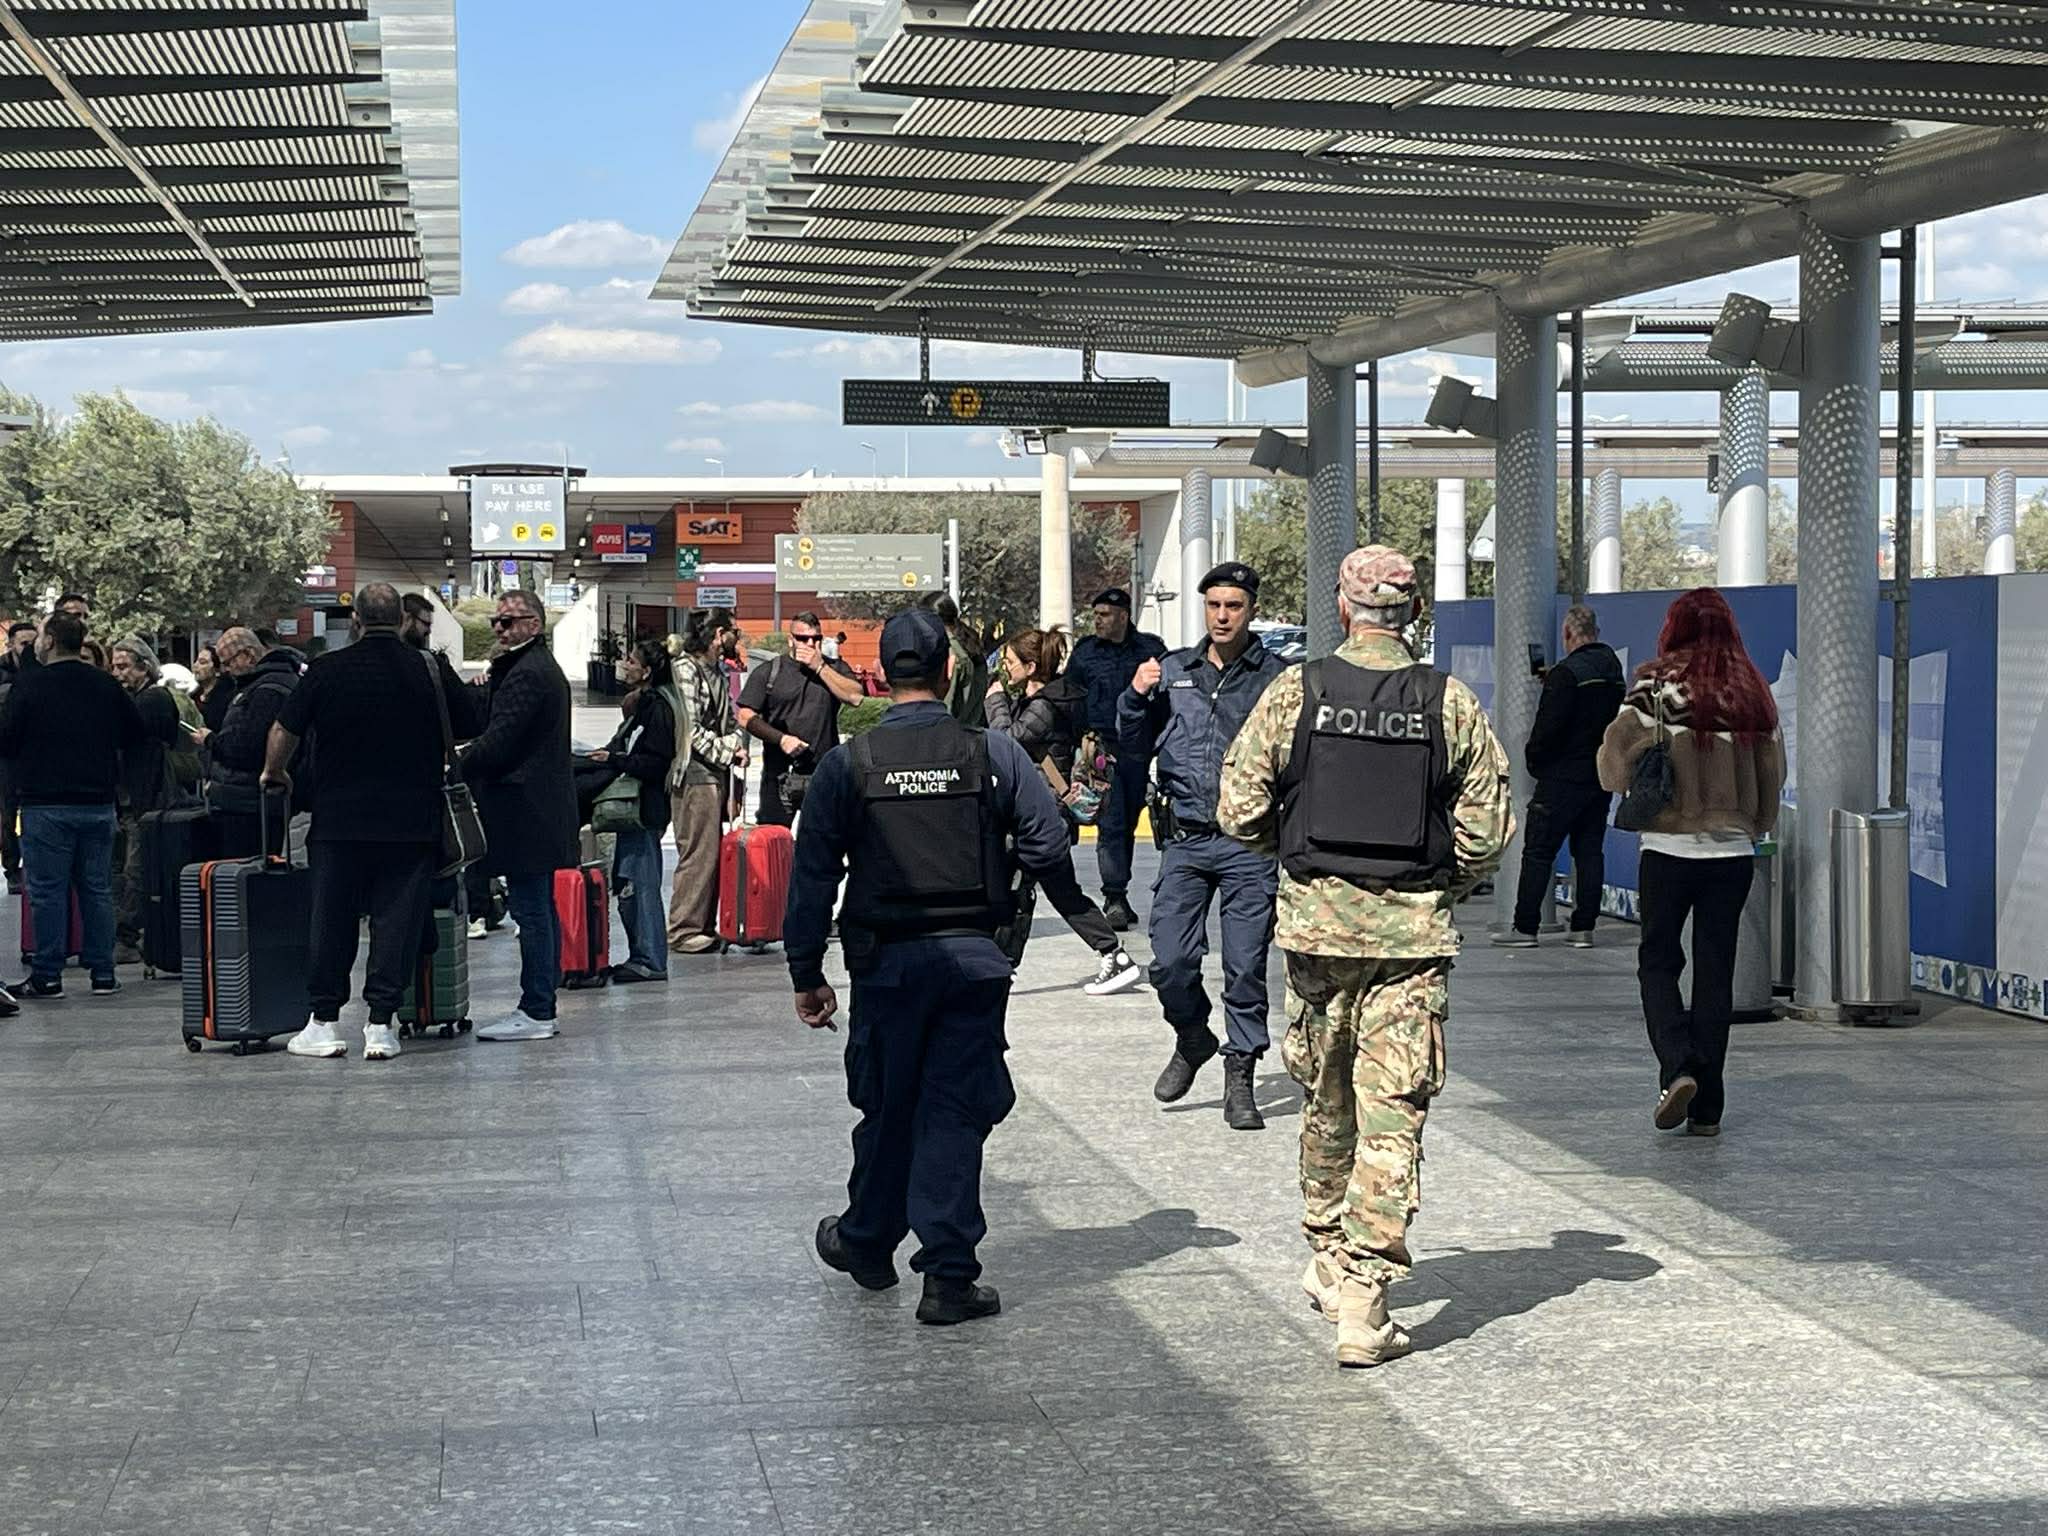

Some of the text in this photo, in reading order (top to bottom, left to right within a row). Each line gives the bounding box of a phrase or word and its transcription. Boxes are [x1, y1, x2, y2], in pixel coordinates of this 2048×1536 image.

[485, 500, 553, 512] PAY HERE
[516, 526, 527, 538] P
[596, 534, 622, 545] AVIS
[1316, 705, 1425, 739] POLICE
[884, 768, 961, 785] ΑΣΤΥΝΟΜΙΑ
[899, 782, 947, 796] POLICE
